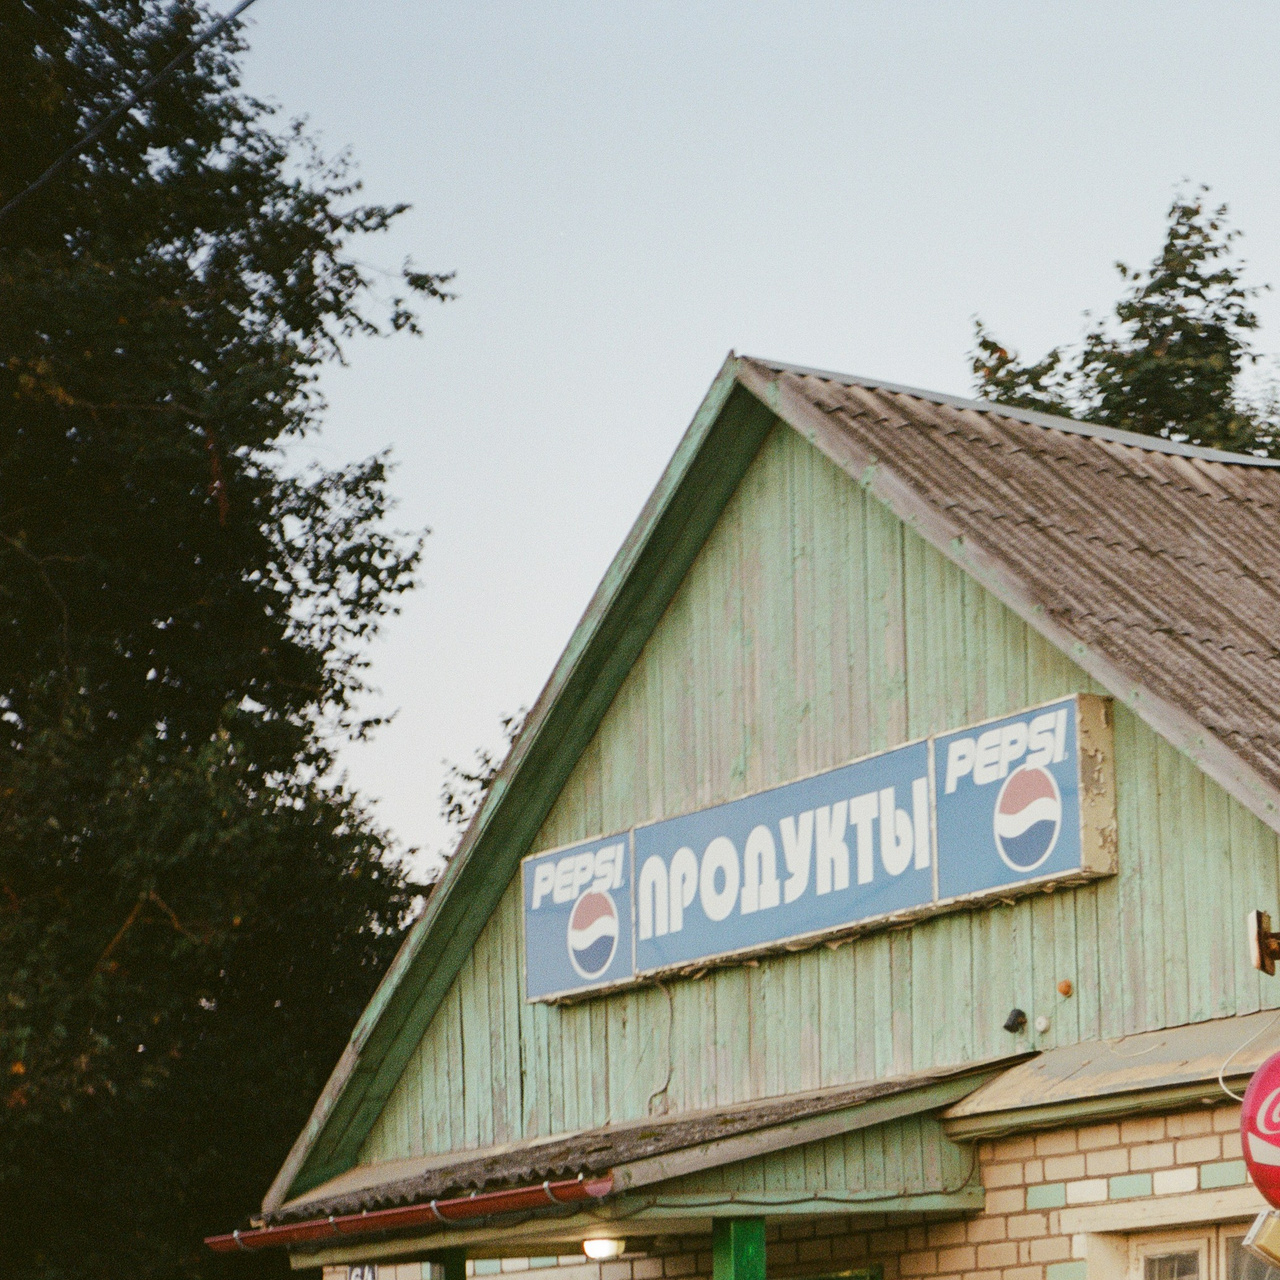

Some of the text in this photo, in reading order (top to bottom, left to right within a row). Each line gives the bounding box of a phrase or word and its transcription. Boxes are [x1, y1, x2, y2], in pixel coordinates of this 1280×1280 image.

[945, 708, 1068, 795] PEPSI
[531, 842, 625, 910] PEPSI
[638, 777, 931, 941] ПРОДУКТЫ
